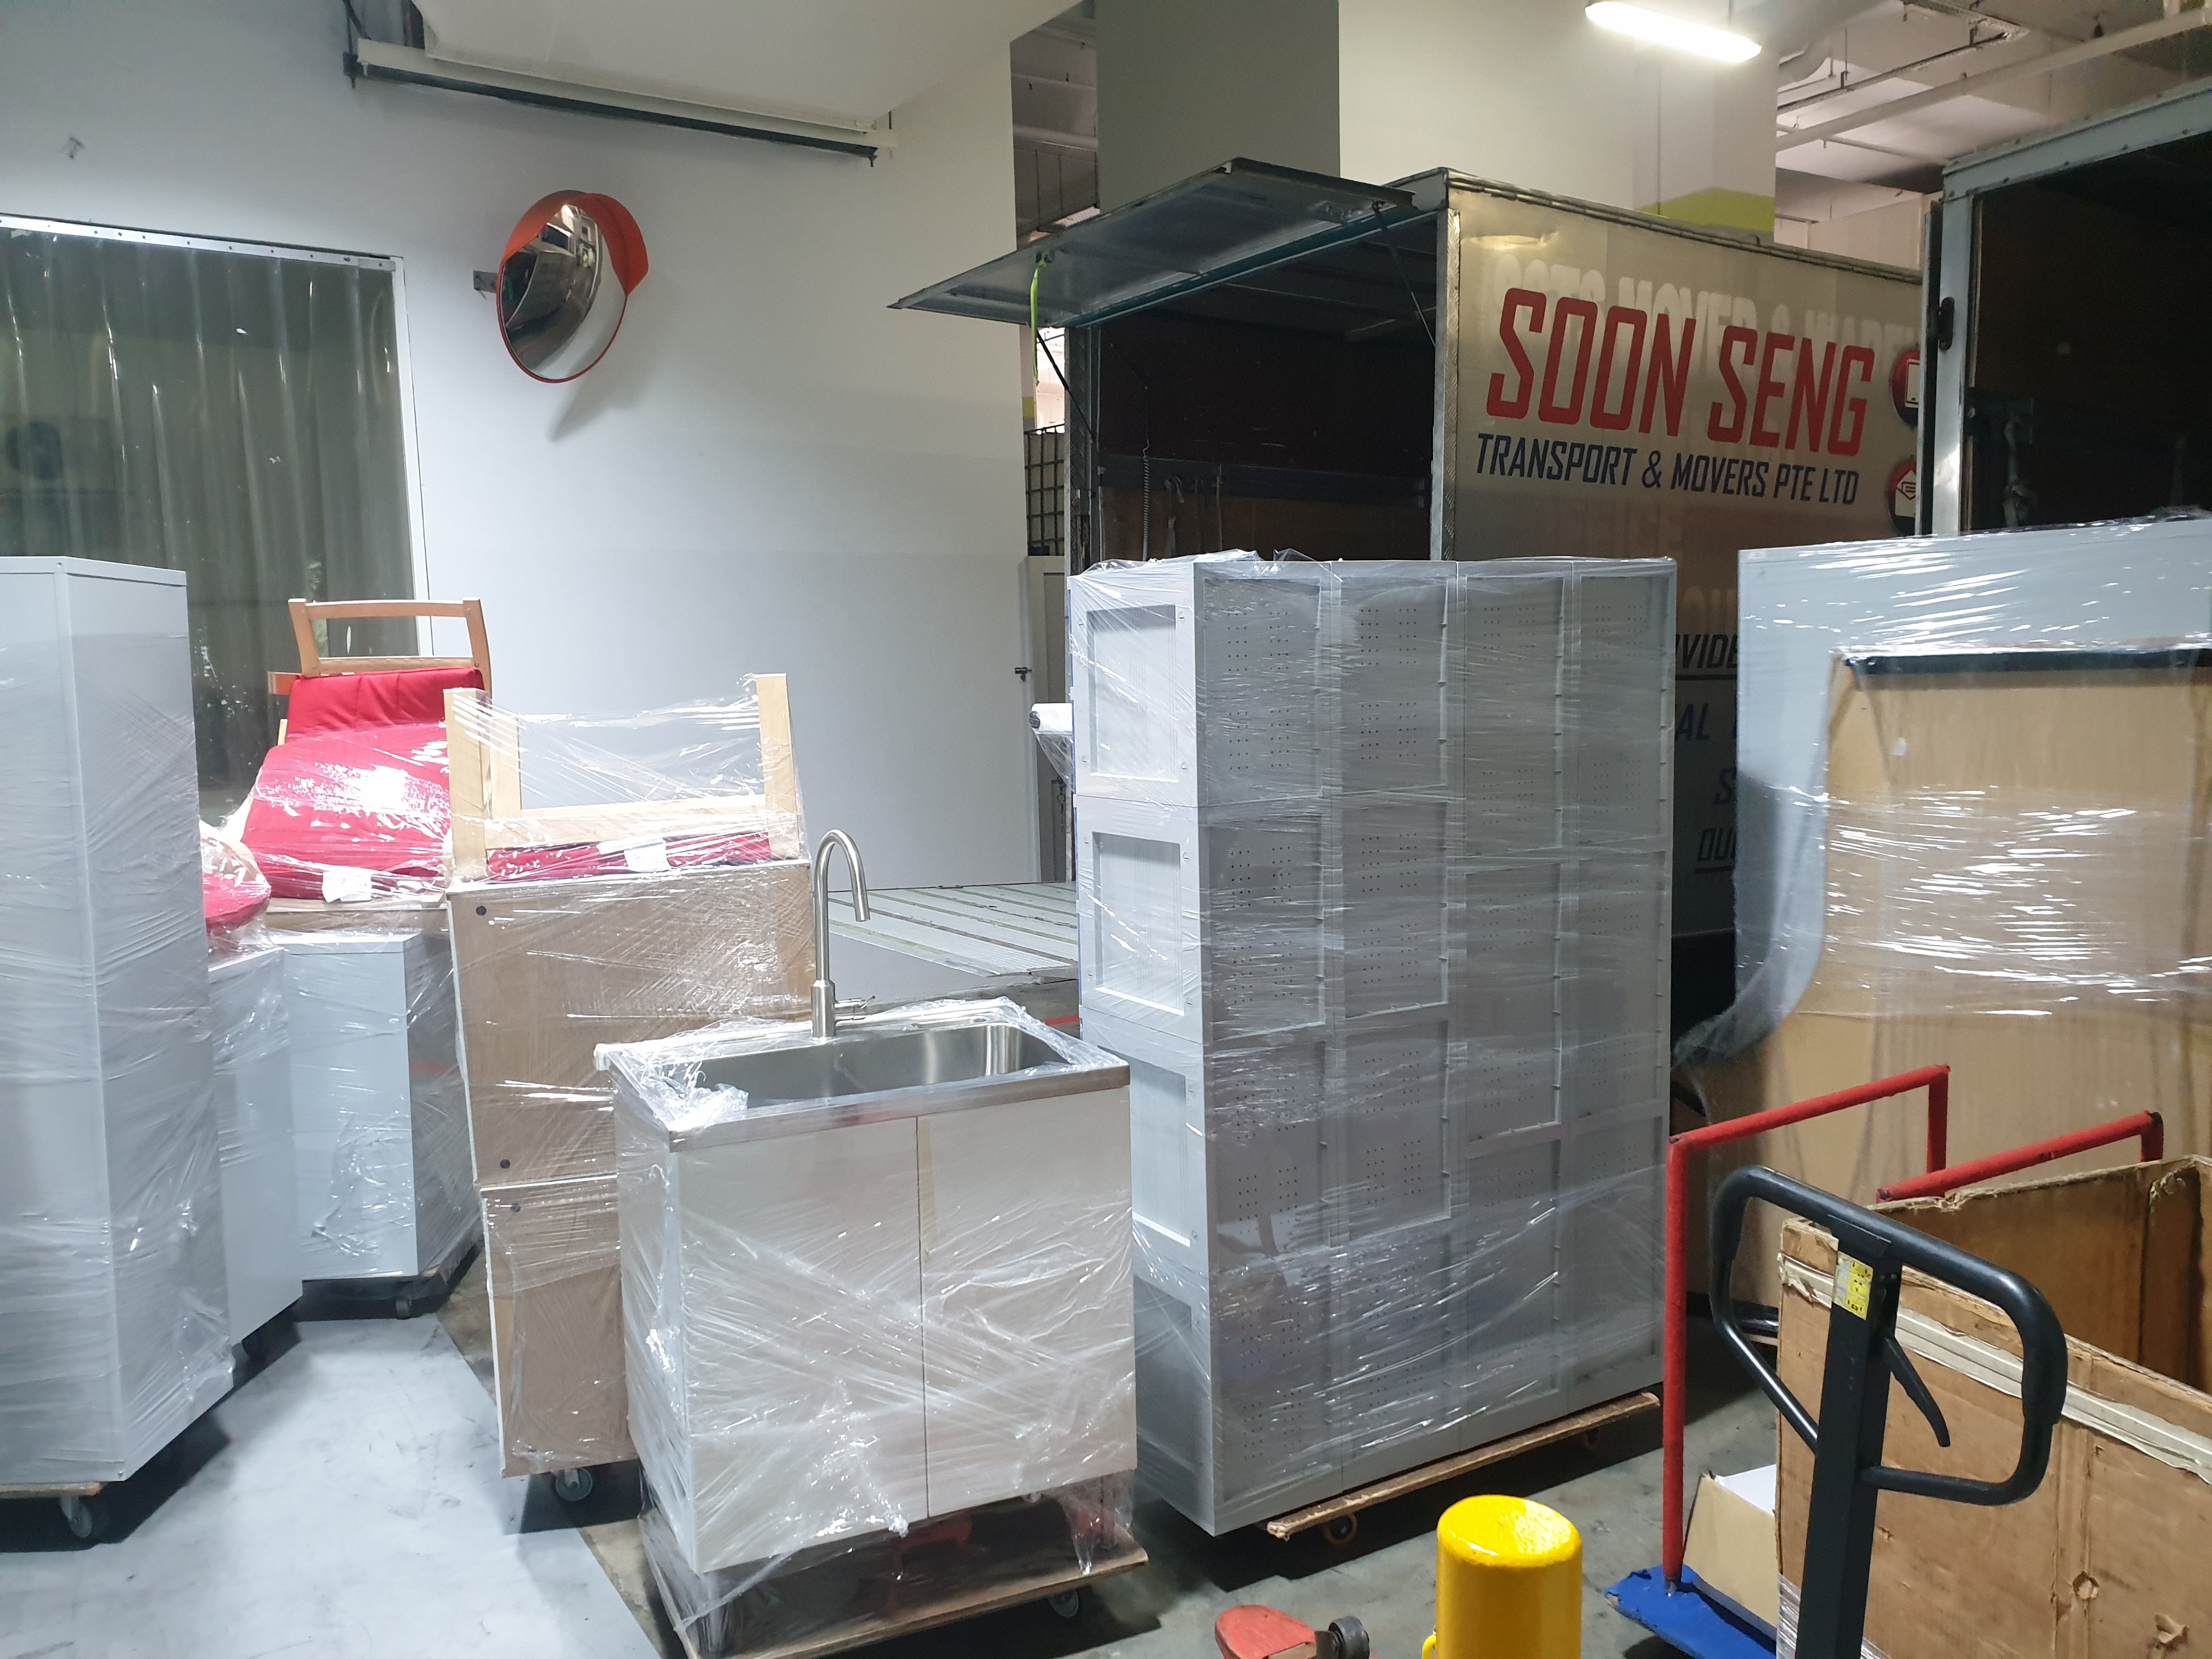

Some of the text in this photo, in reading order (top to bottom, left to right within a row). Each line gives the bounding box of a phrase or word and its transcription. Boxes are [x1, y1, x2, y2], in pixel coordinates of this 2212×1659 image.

[1487, 288, 1696, 436] SOON
[1708, 326, 1875, 456] SENG
[1476, 432, 1860, 505] TRANSPORT & MOVERS PTE LTD
[1675, 703, 1710, 741] AL
